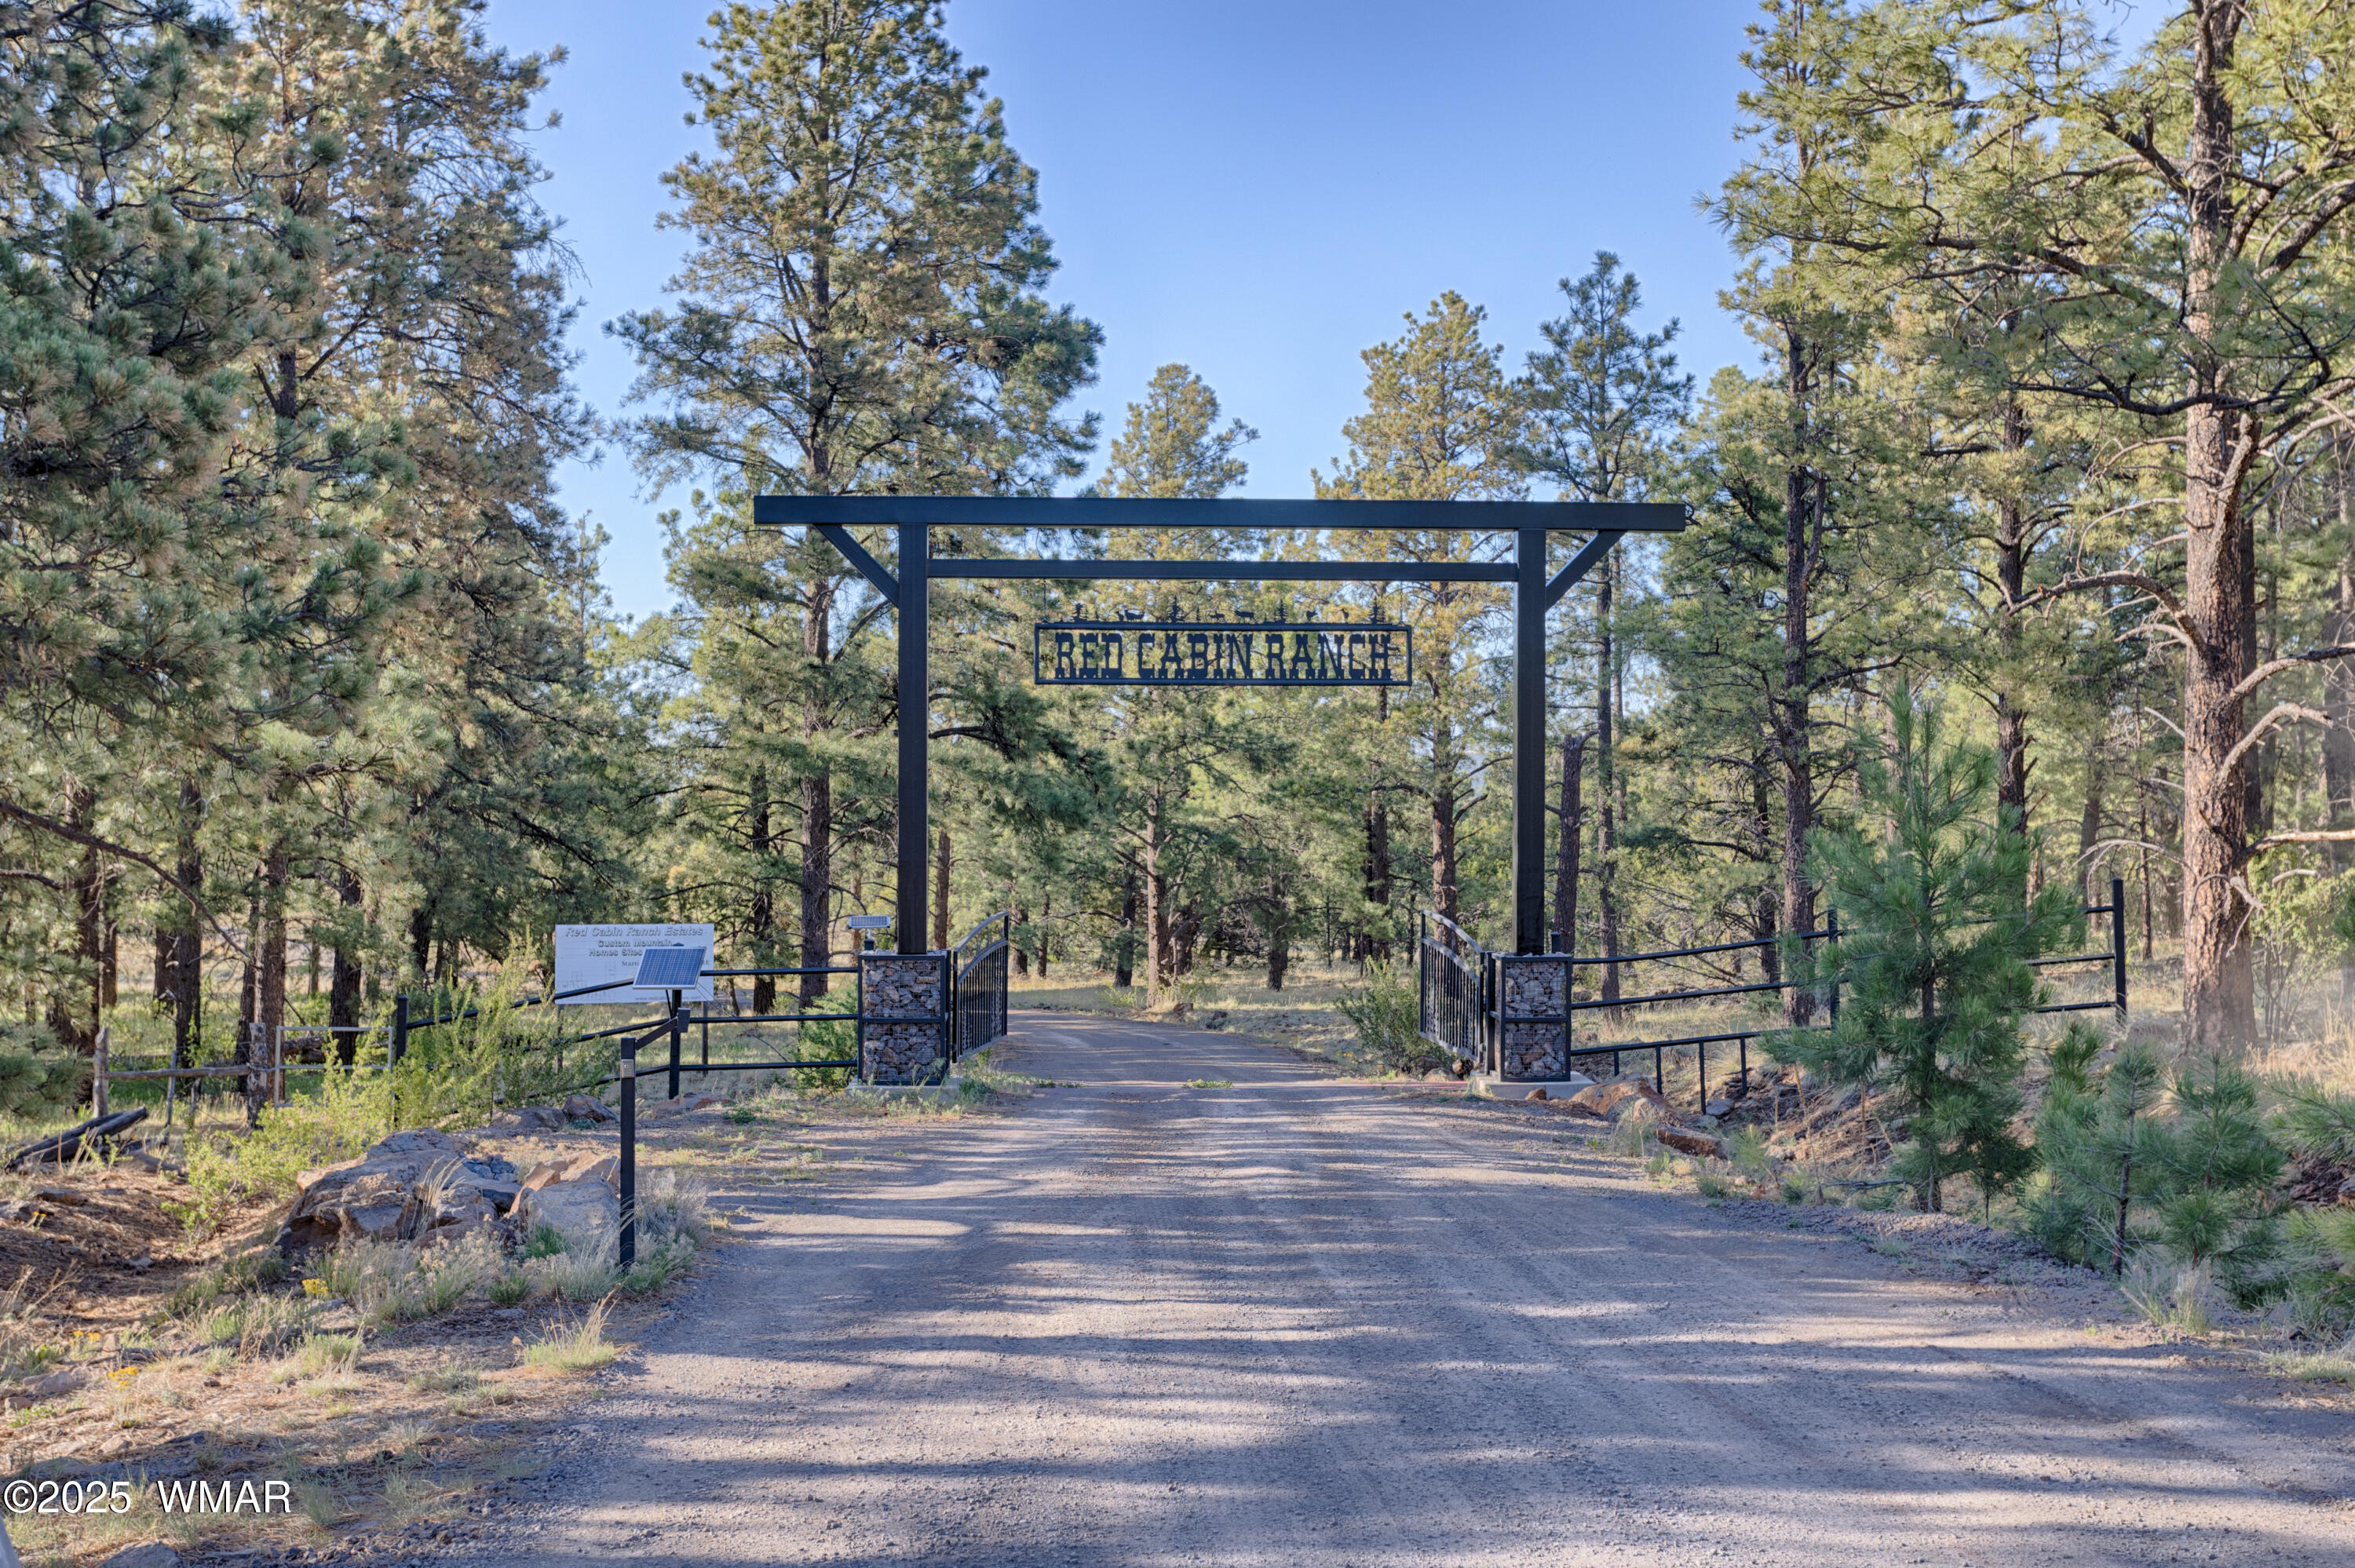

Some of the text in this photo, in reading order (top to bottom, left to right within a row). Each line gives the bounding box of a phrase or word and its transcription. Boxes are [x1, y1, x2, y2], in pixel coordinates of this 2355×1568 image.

[1054, 633, 1393, 680] RED CABIN RANCH
[565, 927, 703, 937] Red Cabin Ranch Estates
[622, 948, 642, 957] Sites
